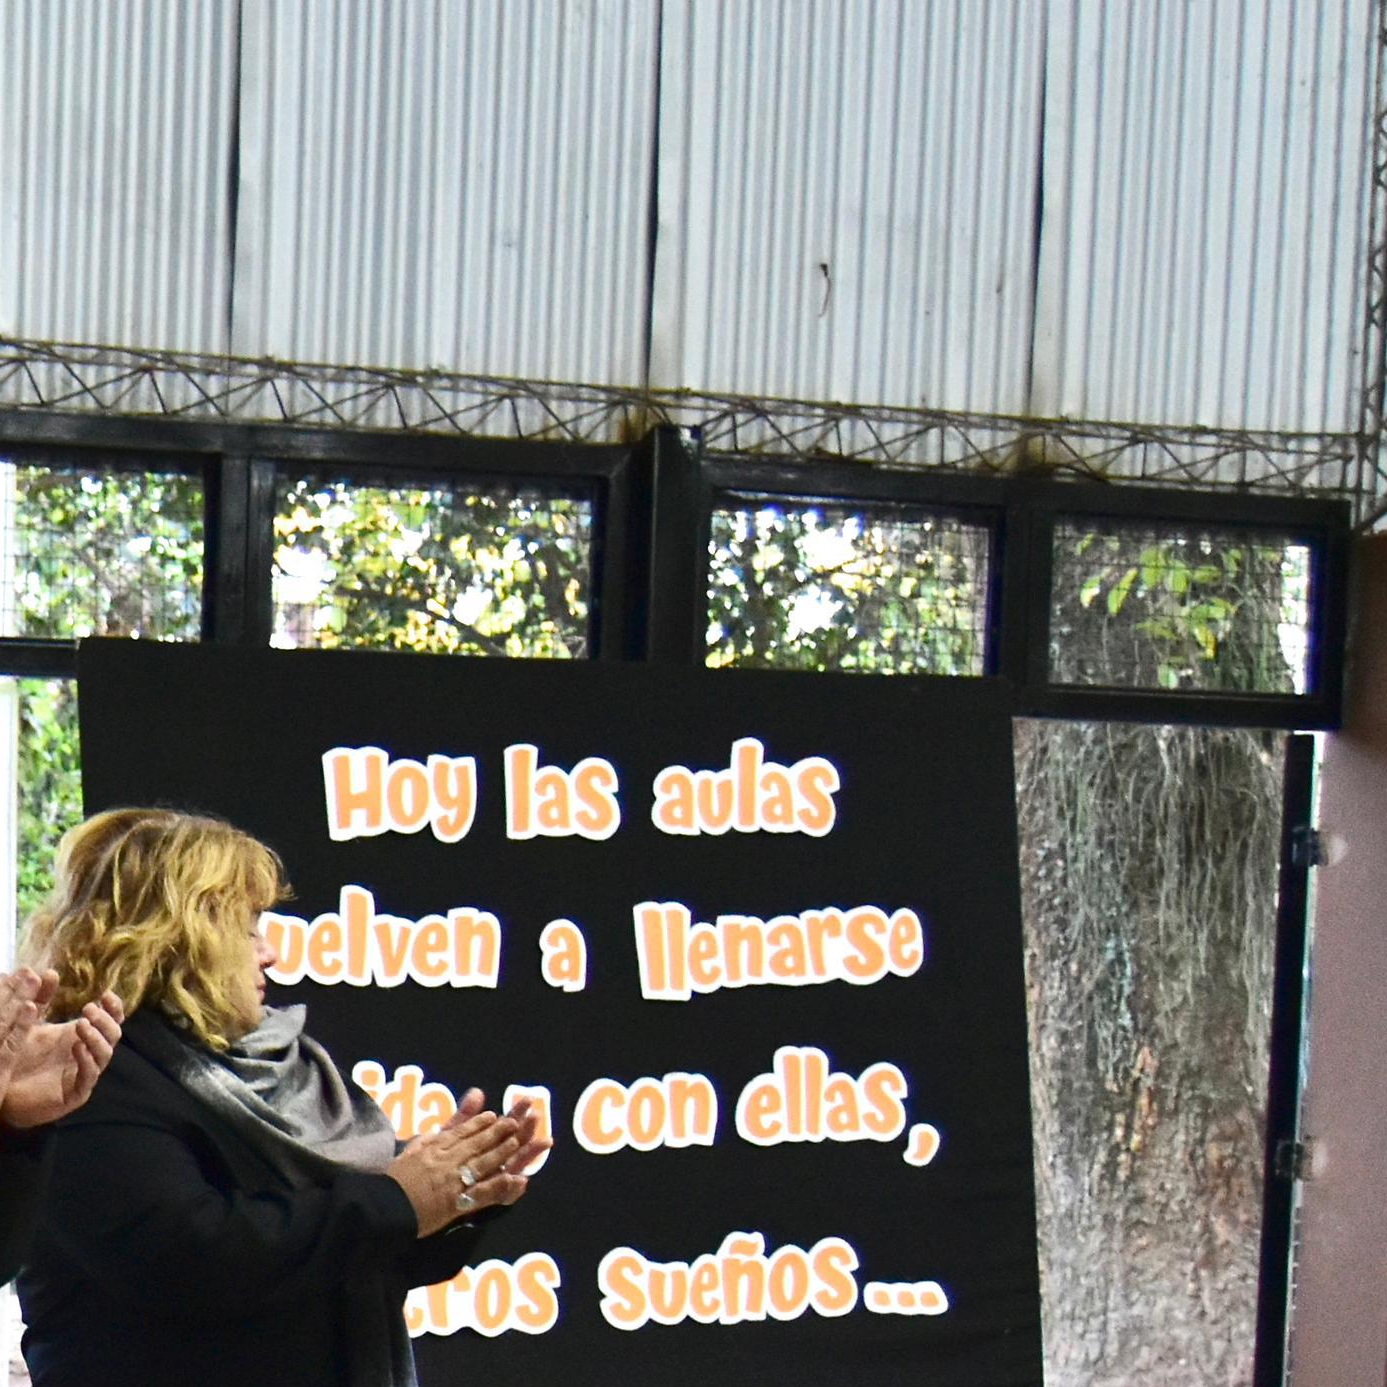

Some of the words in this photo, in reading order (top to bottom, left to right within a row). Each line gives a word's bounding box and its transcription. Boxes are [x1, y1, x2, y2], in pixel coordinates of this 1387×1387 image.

[323, 747, 476, 842] Hoy
[505, 744, 620, 839] las
[652, 738, 840, 837] aulas
[542, 922, 584, 989] a
[634, 902, 923, 1000] llenarse
[574, 1072, 717, 1153] con
[736, 1046, 940, 1166] ellas,
